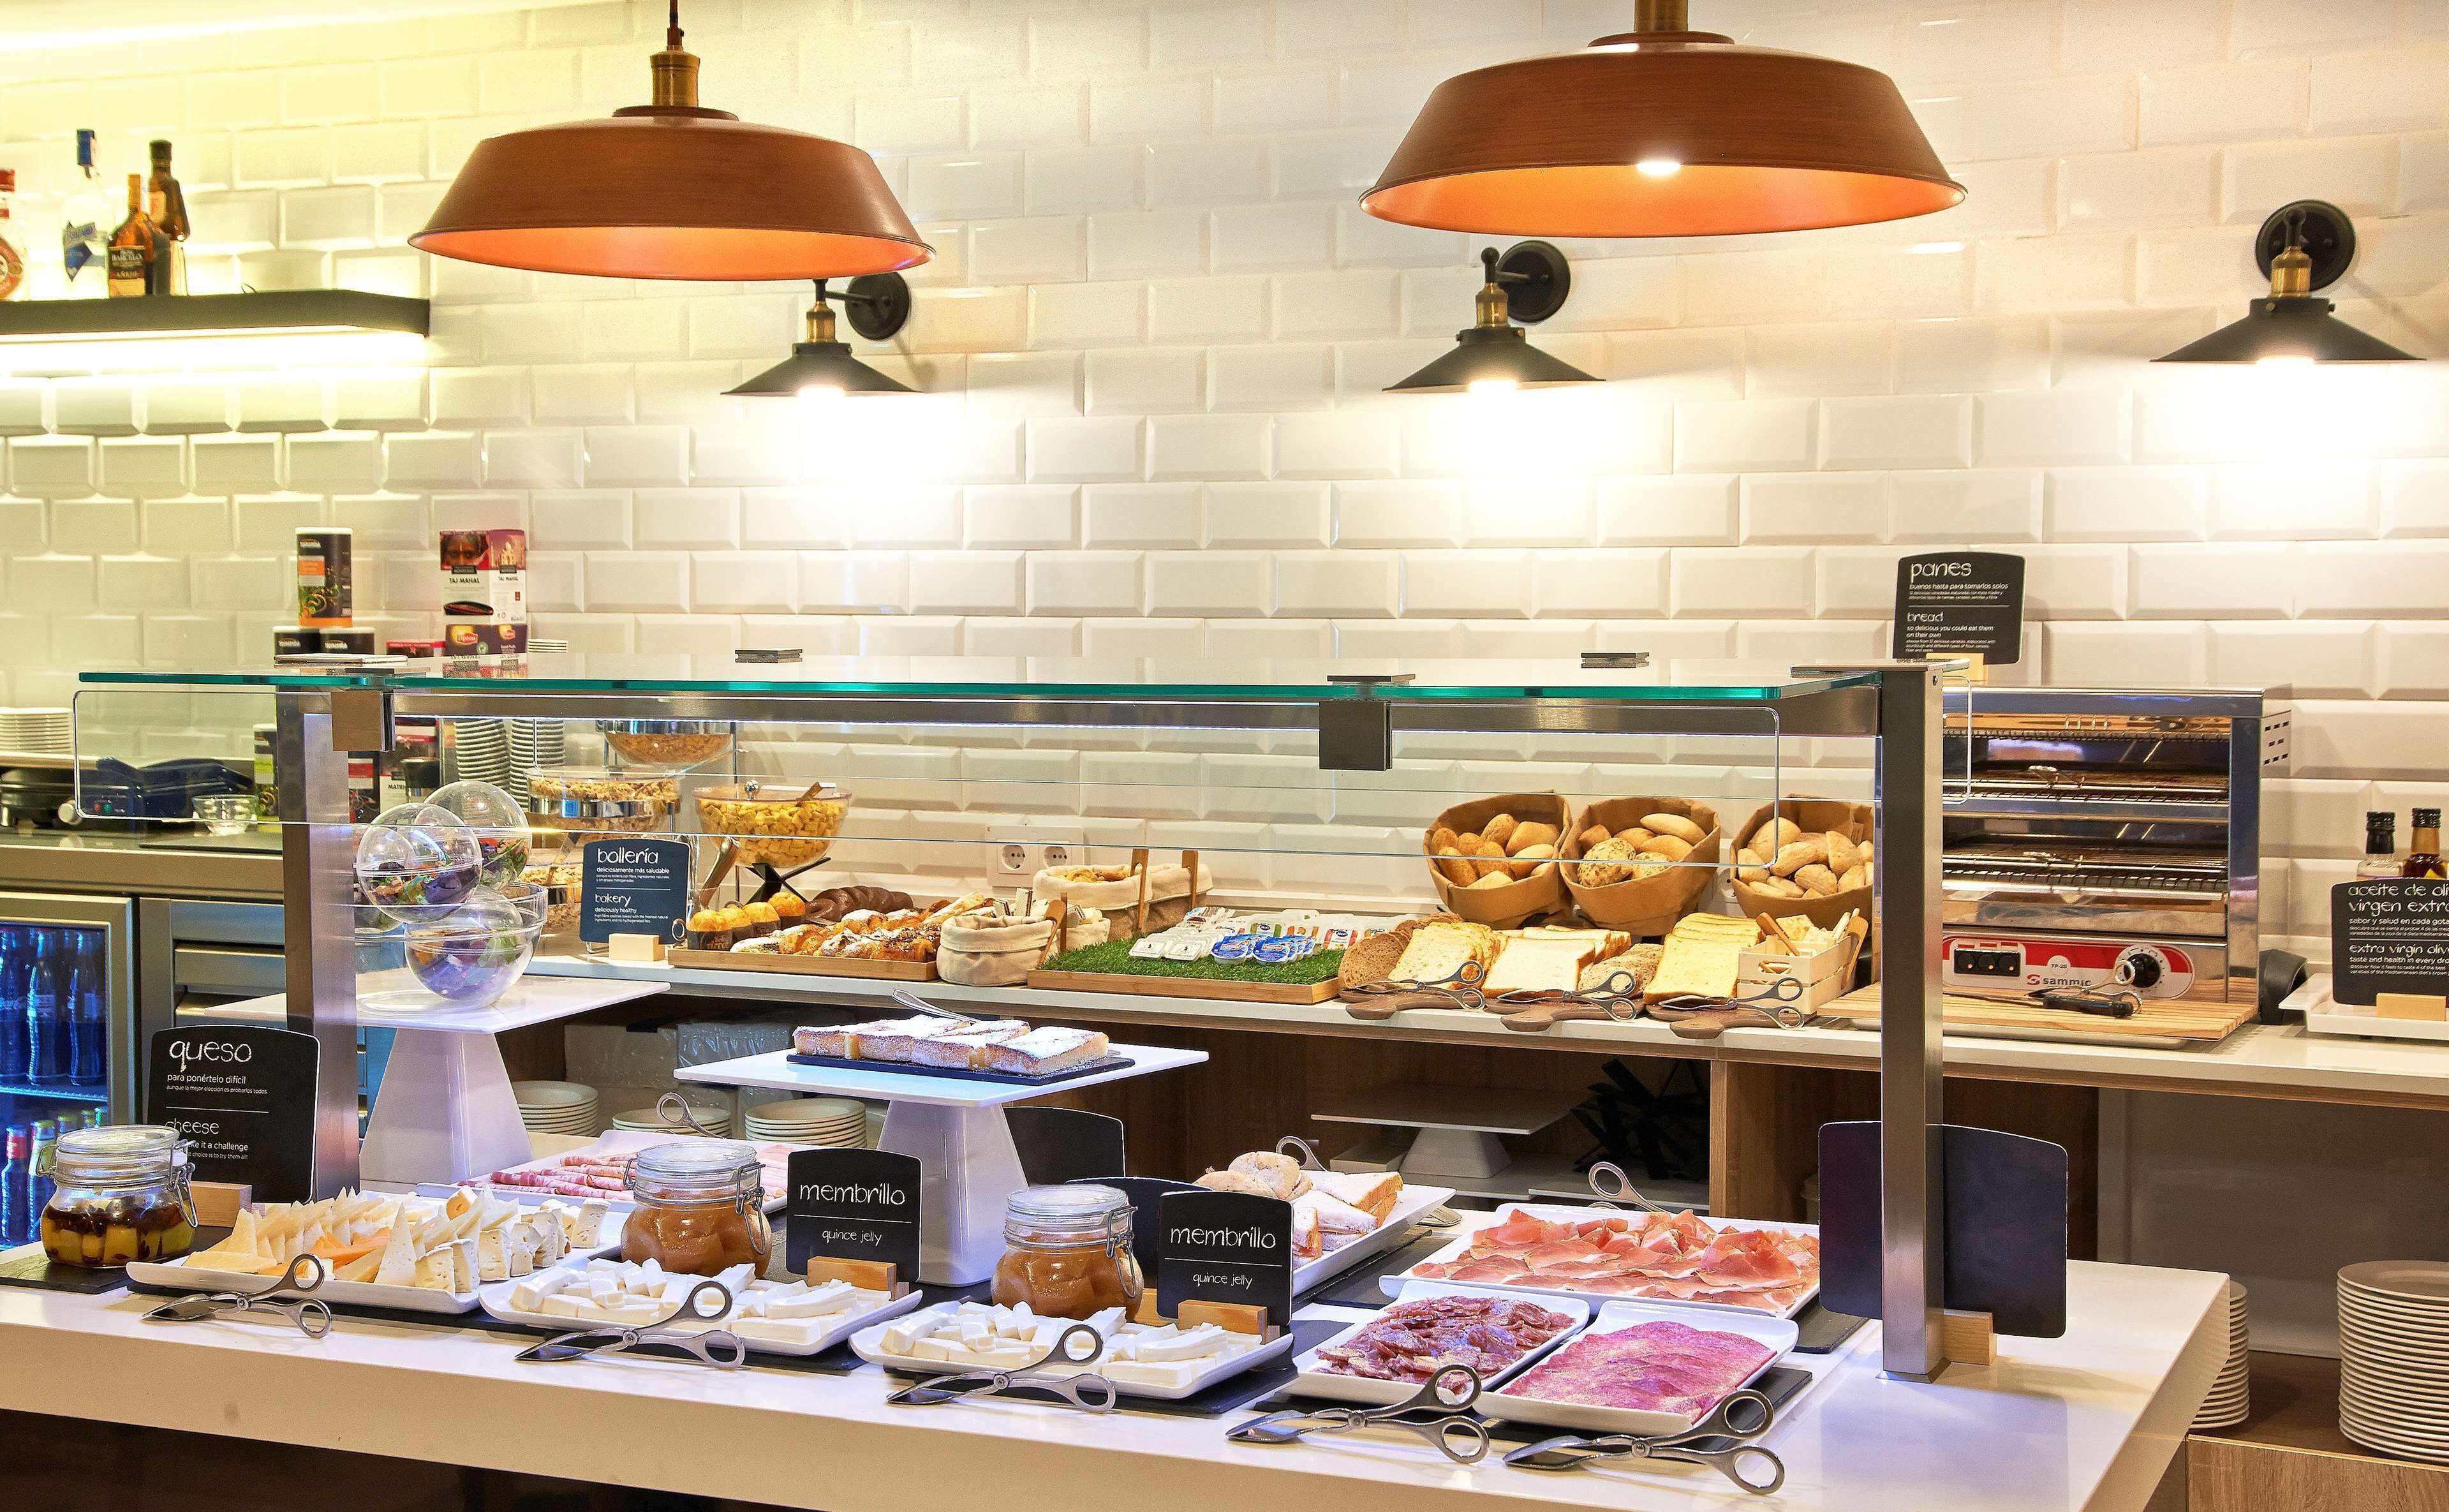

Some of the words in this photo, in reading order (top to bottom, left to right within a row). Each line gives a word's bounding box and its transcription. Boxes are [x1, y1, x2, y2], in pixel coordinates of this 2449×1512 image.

[1911, 562, 1972, 583] panes
[1907, 611, 1944, 622] bread
[597, 847, 658, 864] bollería
[2348, 884, 2399, 896] aceite
[2405, 884, 2427, 896] de
[595, 893, 631, 907] bakery
[2348, 899, 2401, 917] virgen
[2349, 944, 2385, 953] extra
[2389, 944, 2423, 957] virgin
[2427, 944, 2449, 954] oliv
[2043, 977, 2092, 986] sammic
[169, 1041, 251, 1072] queso
[186, 1074, 223, 1083] ponértelo
[214, 1142, 248, 1152] challenge
[799, 1183, 905, 1205] membrillo
[822, 1229, 857, 1243] quince
[860, 1231, 882, 1247] jelly
[1171, 1226, 1276, 1249] membrillo
[1193, 1272, 1228, 1287] quince
[1231, 1274, 1253, 1290] jelly
